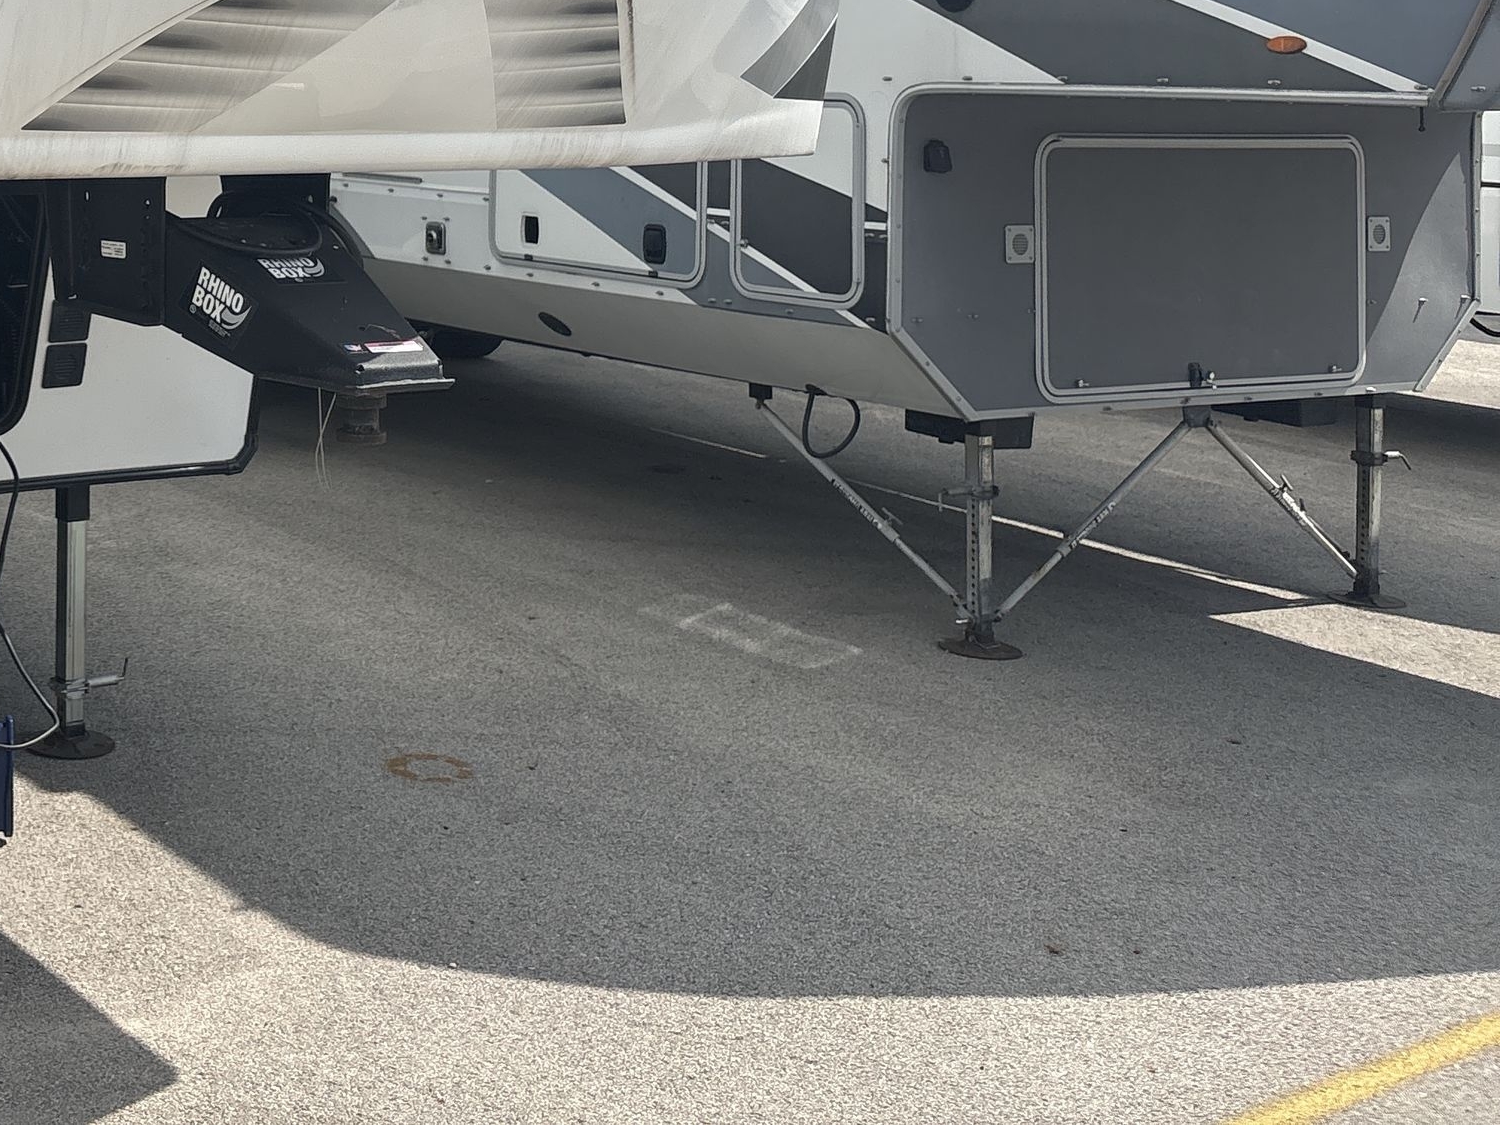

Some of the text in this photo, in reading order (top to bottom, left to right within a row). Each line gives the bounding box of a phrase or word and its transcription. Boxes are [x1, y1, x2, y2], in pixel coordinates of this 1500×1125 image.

[257, 257, 316, 269] RHINO
[267, 266, 312, 279] BOX
[197, 266, 245, 314] RHINO
[192, 284, 226, 324] BOX
